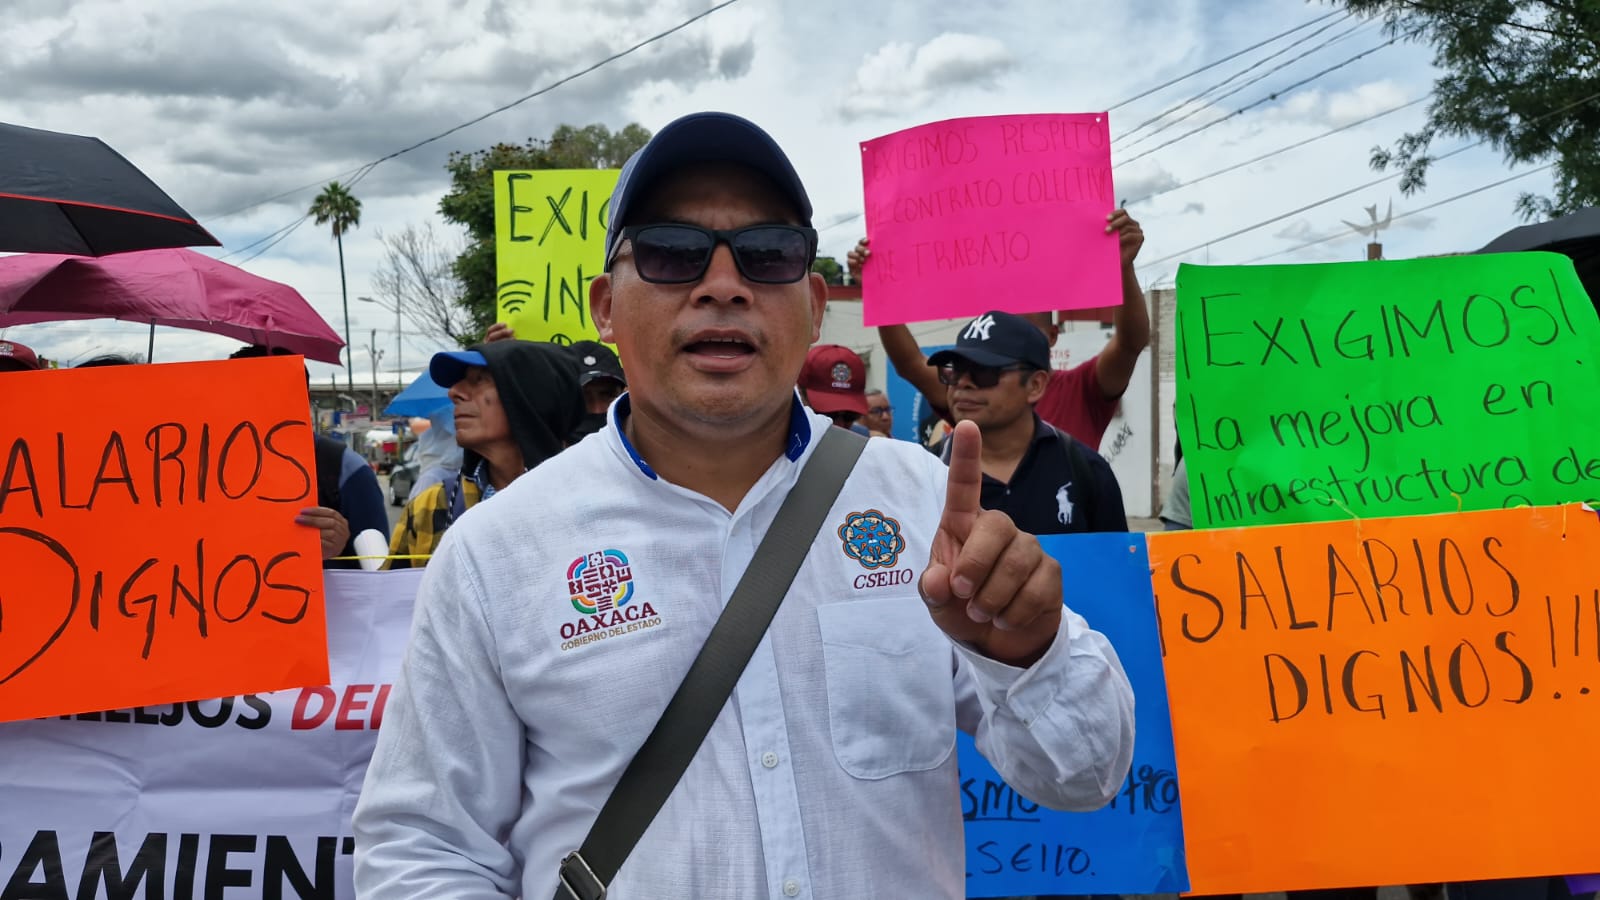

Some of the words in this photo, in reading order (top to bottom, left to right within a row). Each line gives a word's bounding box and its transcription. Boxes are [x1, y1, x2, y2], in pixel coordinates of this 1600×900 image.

[893, 178, 1003, 224] CONTRATO
[874, 248, 898, 284] DE
[912, 231, 1031, 278] TRABAJO
[543, 261, 597, 329] IN
[1189, 392, 1245, 452] La
[1269, 393, 1443, 473] mejora
[1482, 379, 1553, 415] en
[1200, 453, 1532, 525] Infraestructura
[853, 568, 913, 589] CSEIIO
[560, 601, 658, 640] OAXACA
[560, 631, 607, 651] GOBIERNO
[609, 627, 627, 638] DEL
[626, 617, 662, 633] ESTADO
[0, 830, 355, 900] AMIEN
